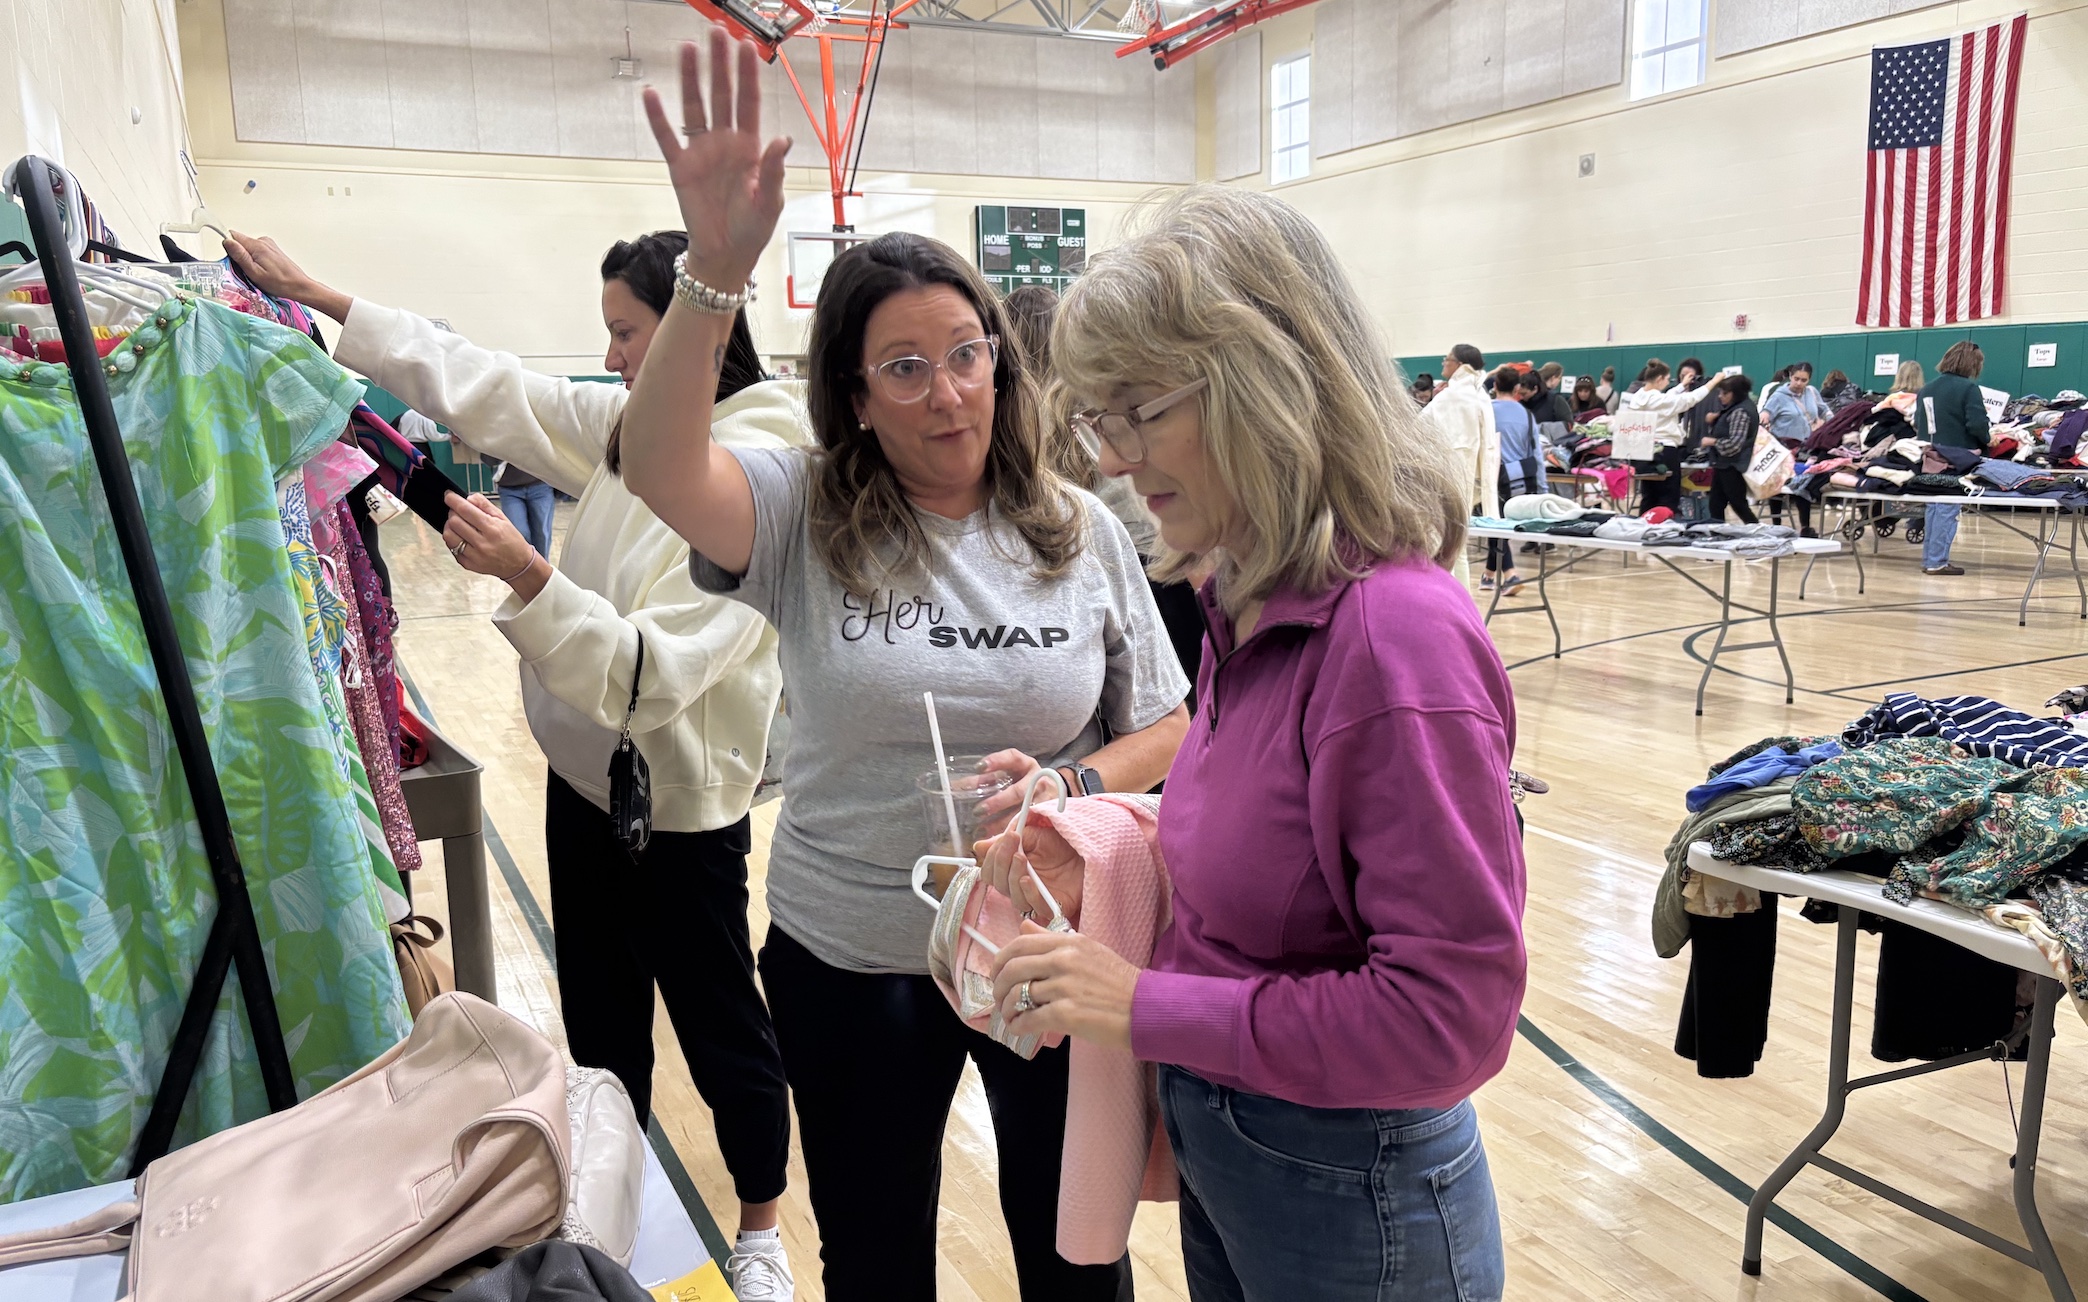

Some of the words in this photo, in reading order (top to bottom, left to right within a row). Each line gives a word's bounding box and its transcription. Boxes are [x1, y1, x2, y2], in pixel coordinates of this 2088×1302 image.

[984, 235, 1009, 245] HOME
[1057, 237, 1084, 247] GUEST
[842, 589, 943, 645] Her
[929, 625, 1070, 650] SWAP
